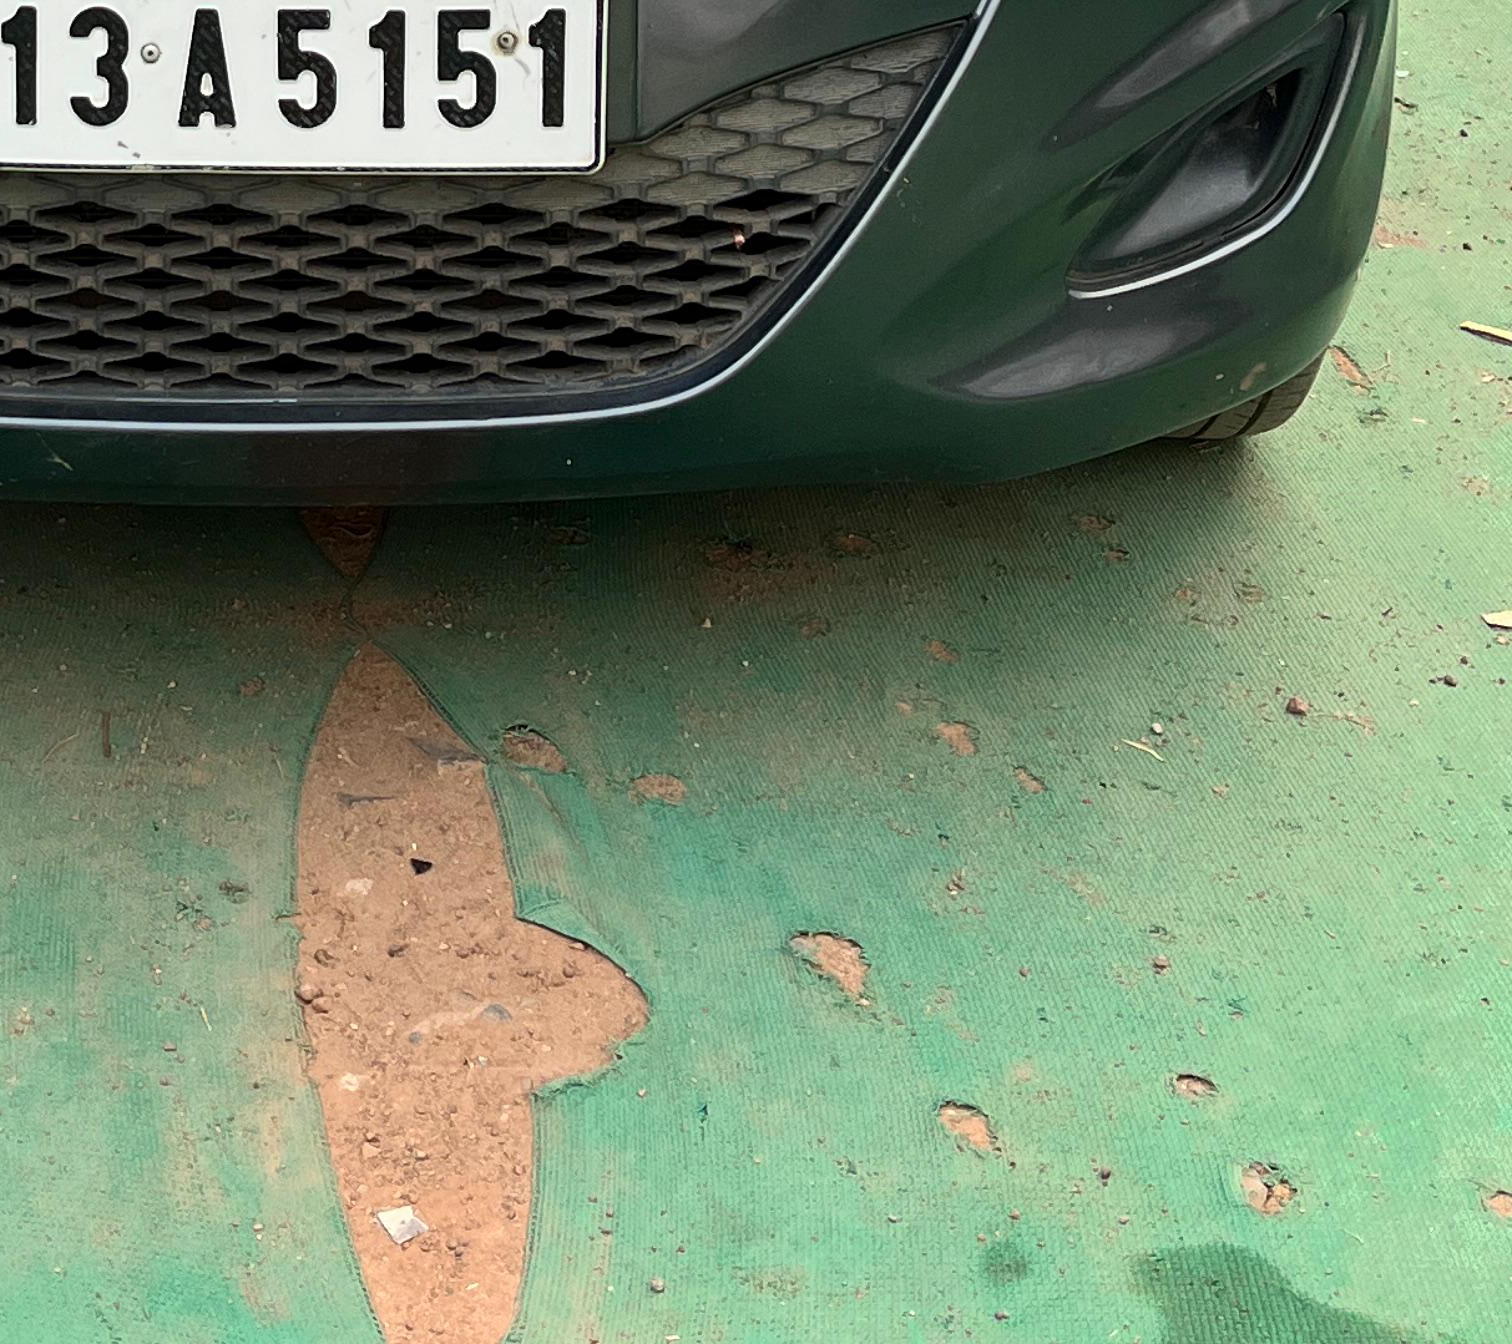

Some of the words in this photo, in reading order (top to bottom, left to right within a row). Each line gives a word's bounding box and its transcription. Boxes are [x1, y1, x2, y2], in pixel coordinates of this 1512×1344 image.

[1, 5, 131, 126] 13
[177, 9, 237, 128] A
[276, 8, 567, 130] 5151
